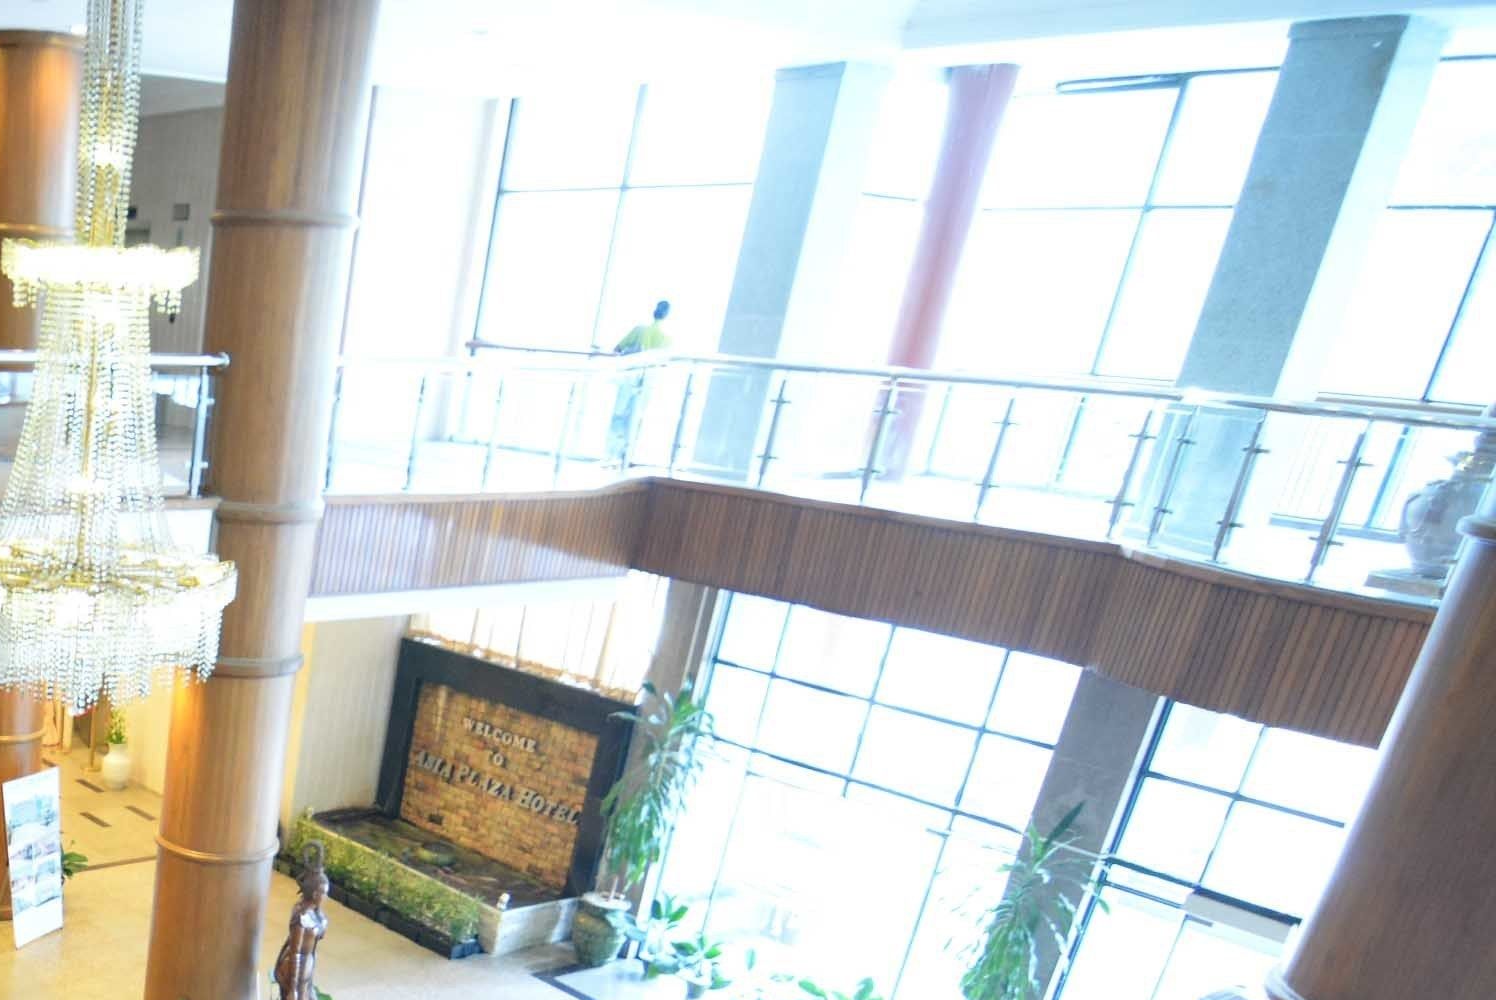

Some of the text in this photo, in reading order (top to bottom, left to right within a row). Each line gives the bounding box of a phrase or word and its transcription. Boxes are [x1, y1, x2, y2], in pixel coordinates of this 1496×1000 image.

[463, 717, 536, 752] WELCOME
[416, 751, 582, 824] ASIA PLAZA HOTEL
